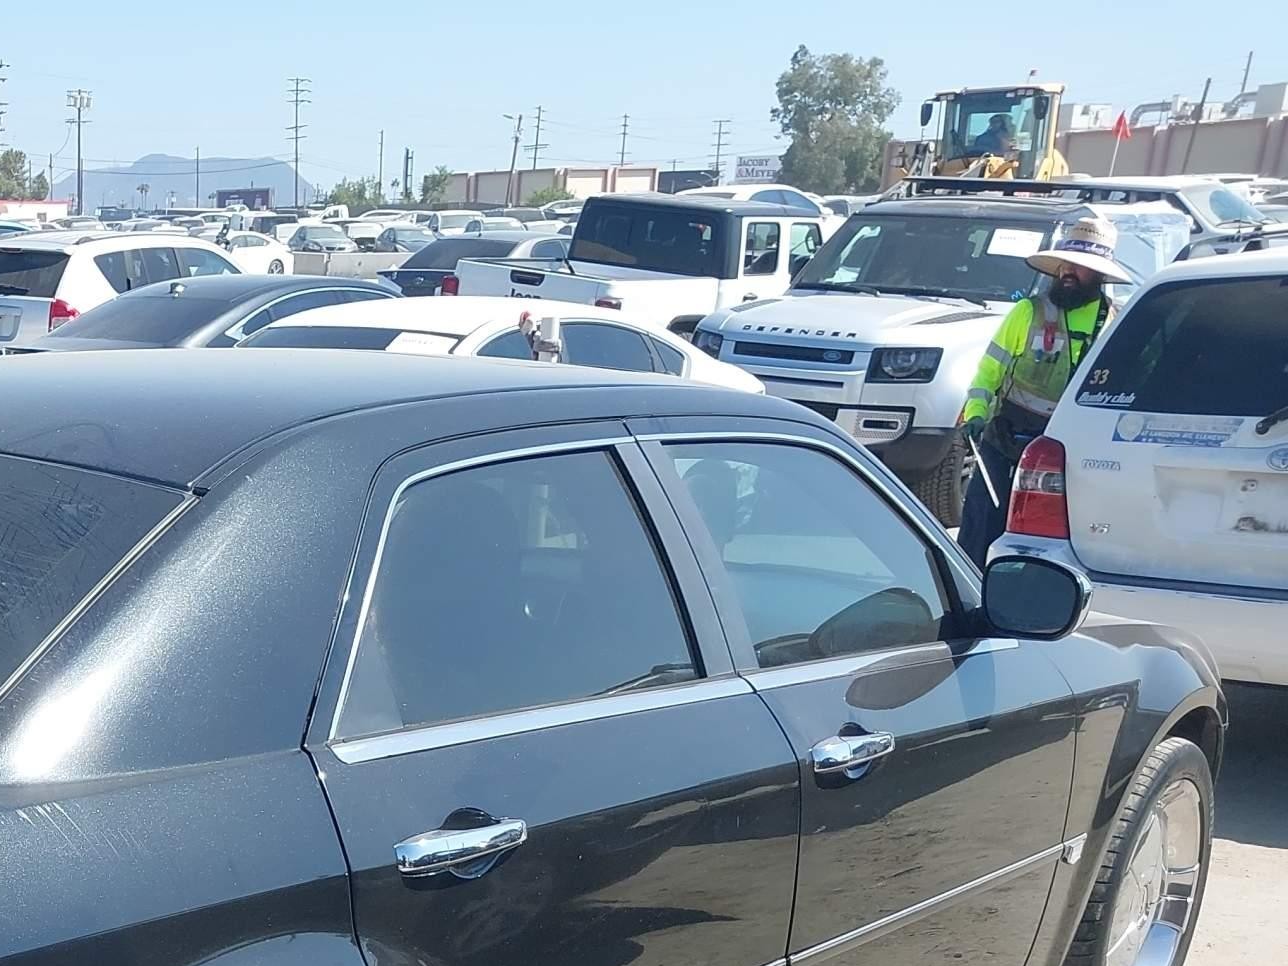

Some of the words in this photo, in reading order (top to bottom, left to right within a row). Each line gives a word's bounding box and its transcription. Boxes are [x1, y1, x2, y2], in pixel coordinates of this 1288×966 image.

[742, 323, 858, 339] DEFENDER
[1089, 369, 1110, 384] 33
[1081, 459, 1120, 471] TOYOTA
